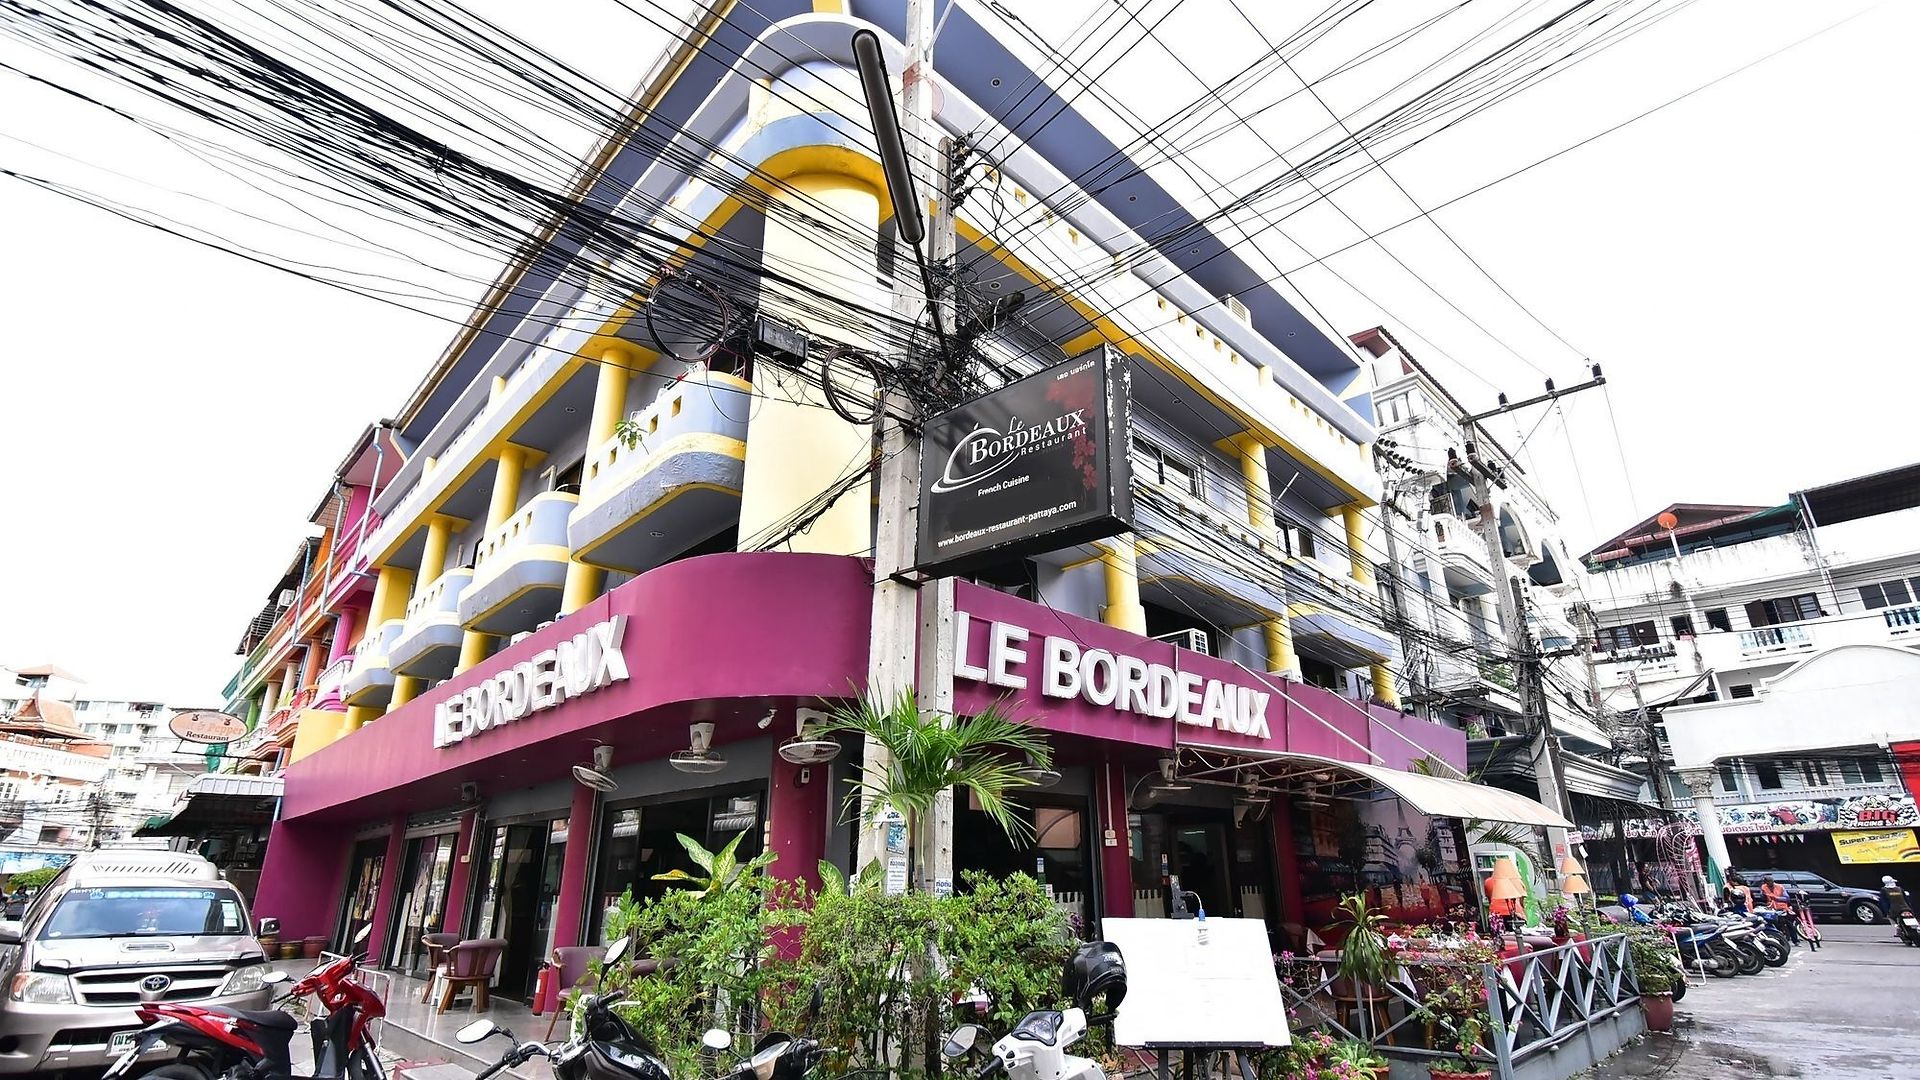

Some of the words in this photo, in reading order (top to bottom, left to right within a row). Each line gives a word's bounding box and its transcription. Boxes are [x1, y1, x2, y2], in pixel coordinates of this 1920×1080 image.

[969, 408, 1086, 466] BORDEAUX
[1007, 415, 1025, 436] Le
[1020, 425, 1087, 456] Restaurant
[977, 481, 1001, 497] French
[1002, 473, 1030, 490] Cuisine
[937, 499, 1077, 548] www.bordeaux-restaurant-pattaya.com
[953, 610, 1030, 690] LE
[1042, 635, 1272, 740] BORDEAUX
[185, 730, 229, 742] Restaurant
[1857, 809, 1898, 824] BIG
